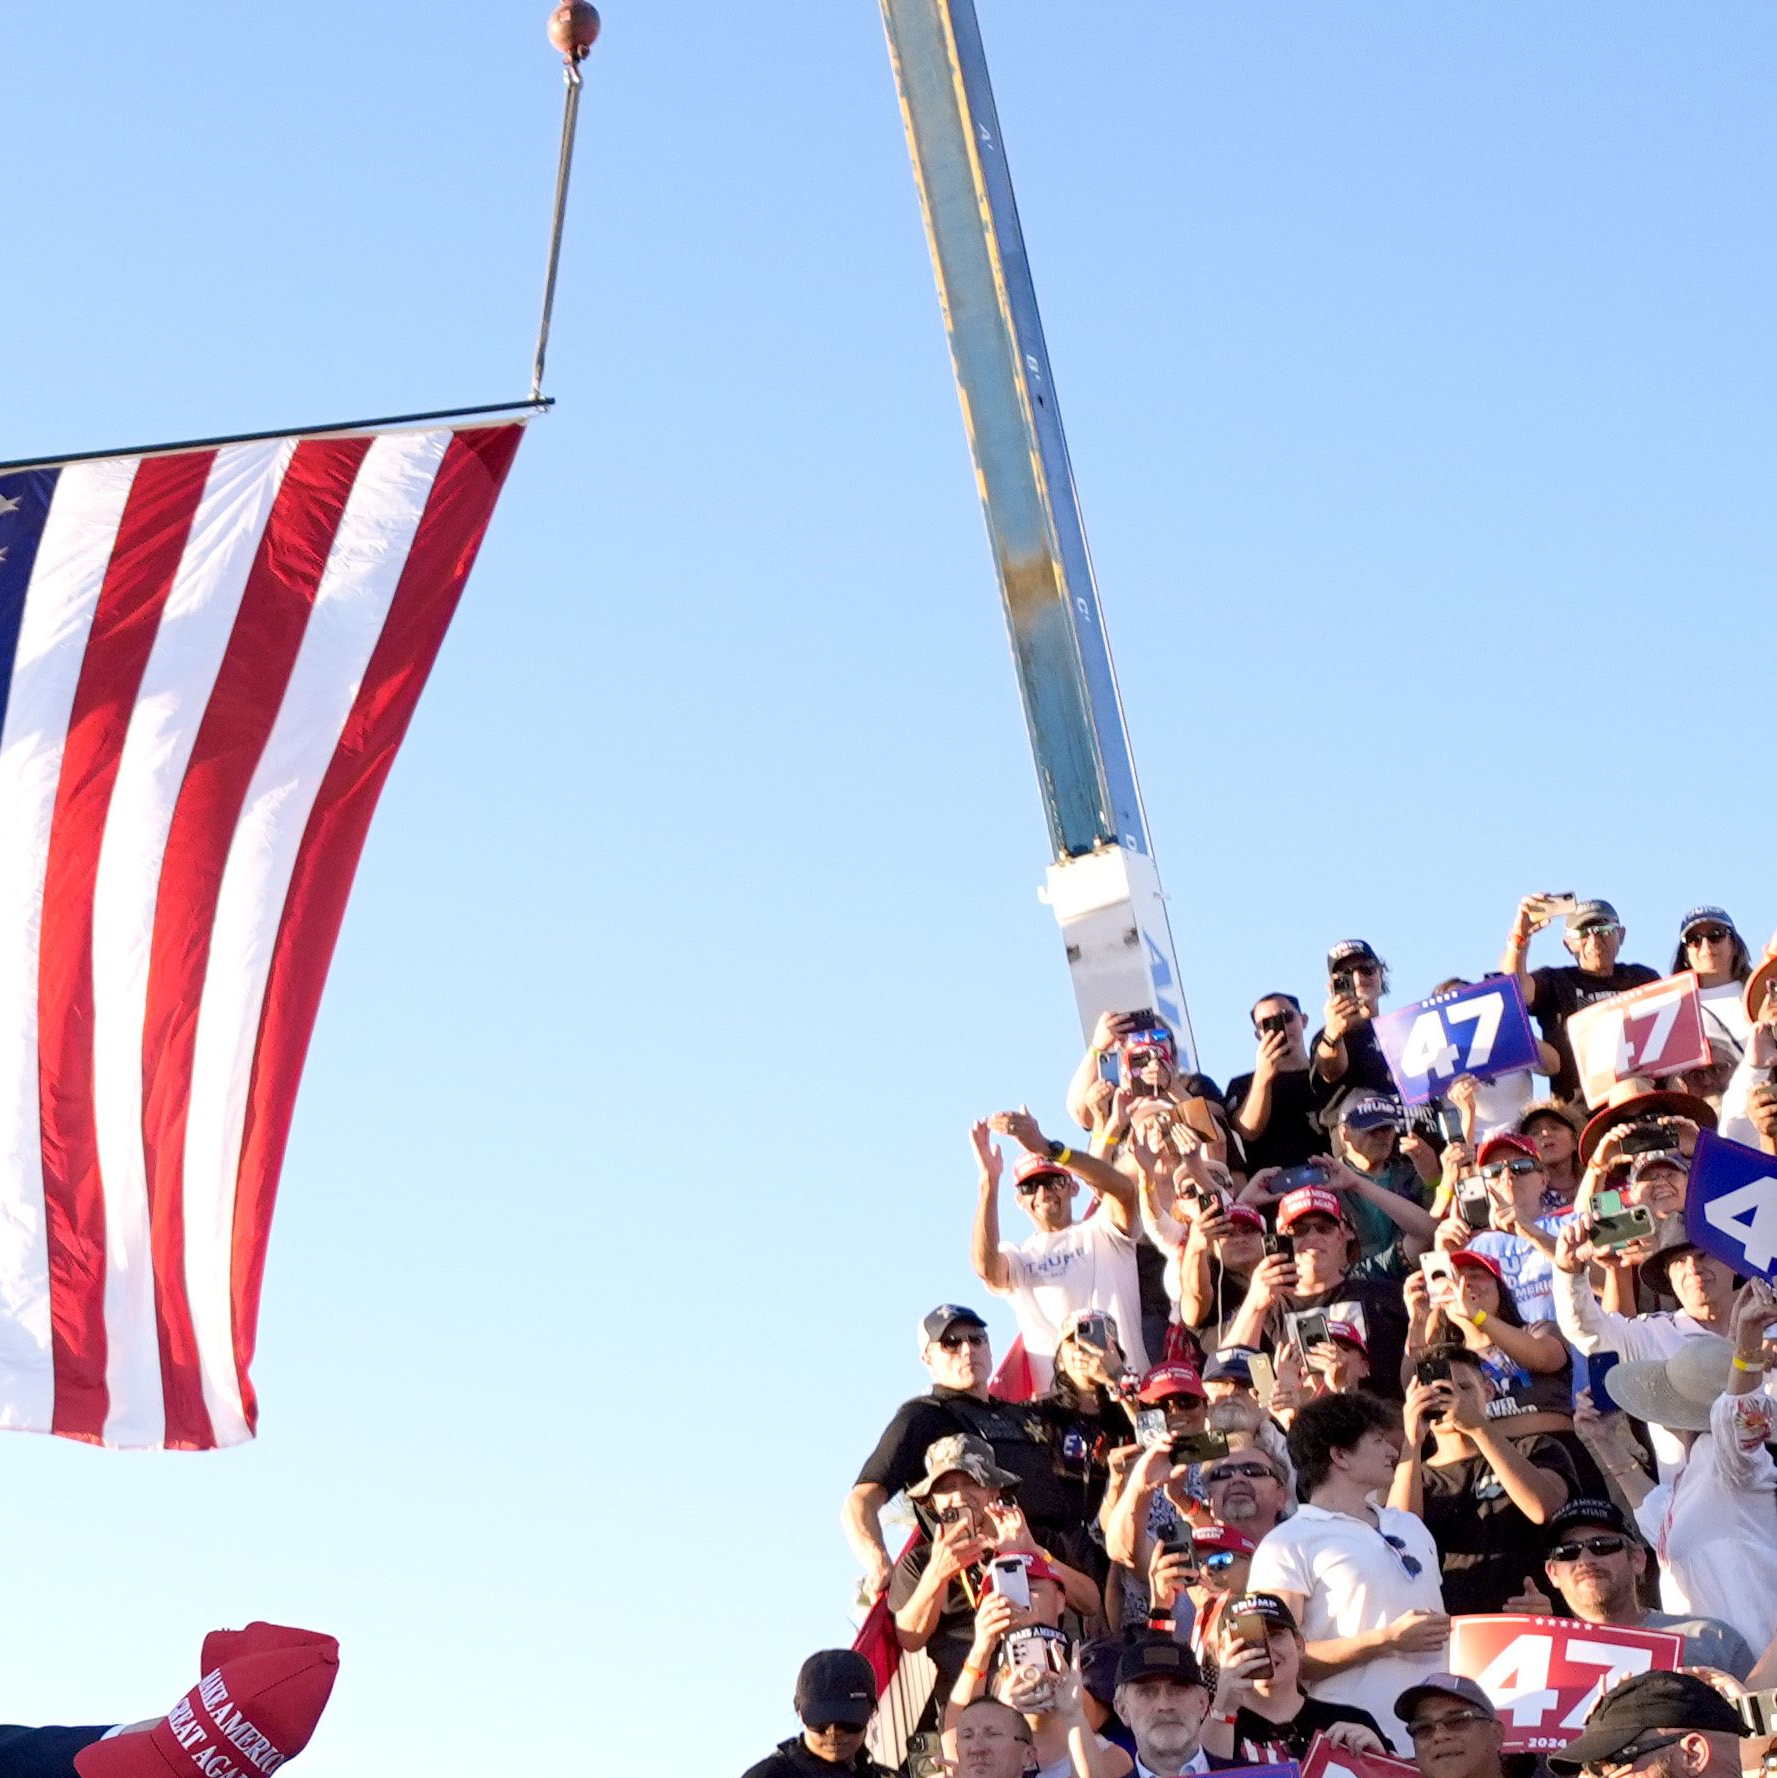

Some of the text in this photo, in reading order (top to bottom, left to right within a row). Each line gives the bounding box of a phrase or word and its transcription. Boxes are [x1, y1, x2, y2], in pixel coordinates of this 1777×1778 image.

[1401, 991, 1505, 1079] 47
[198, 1667, 285, 1776] MAKE AMERIC
[1475, 1633, 1654, 1729] 47
[1528, 1736, 1568, 1749] 2024
